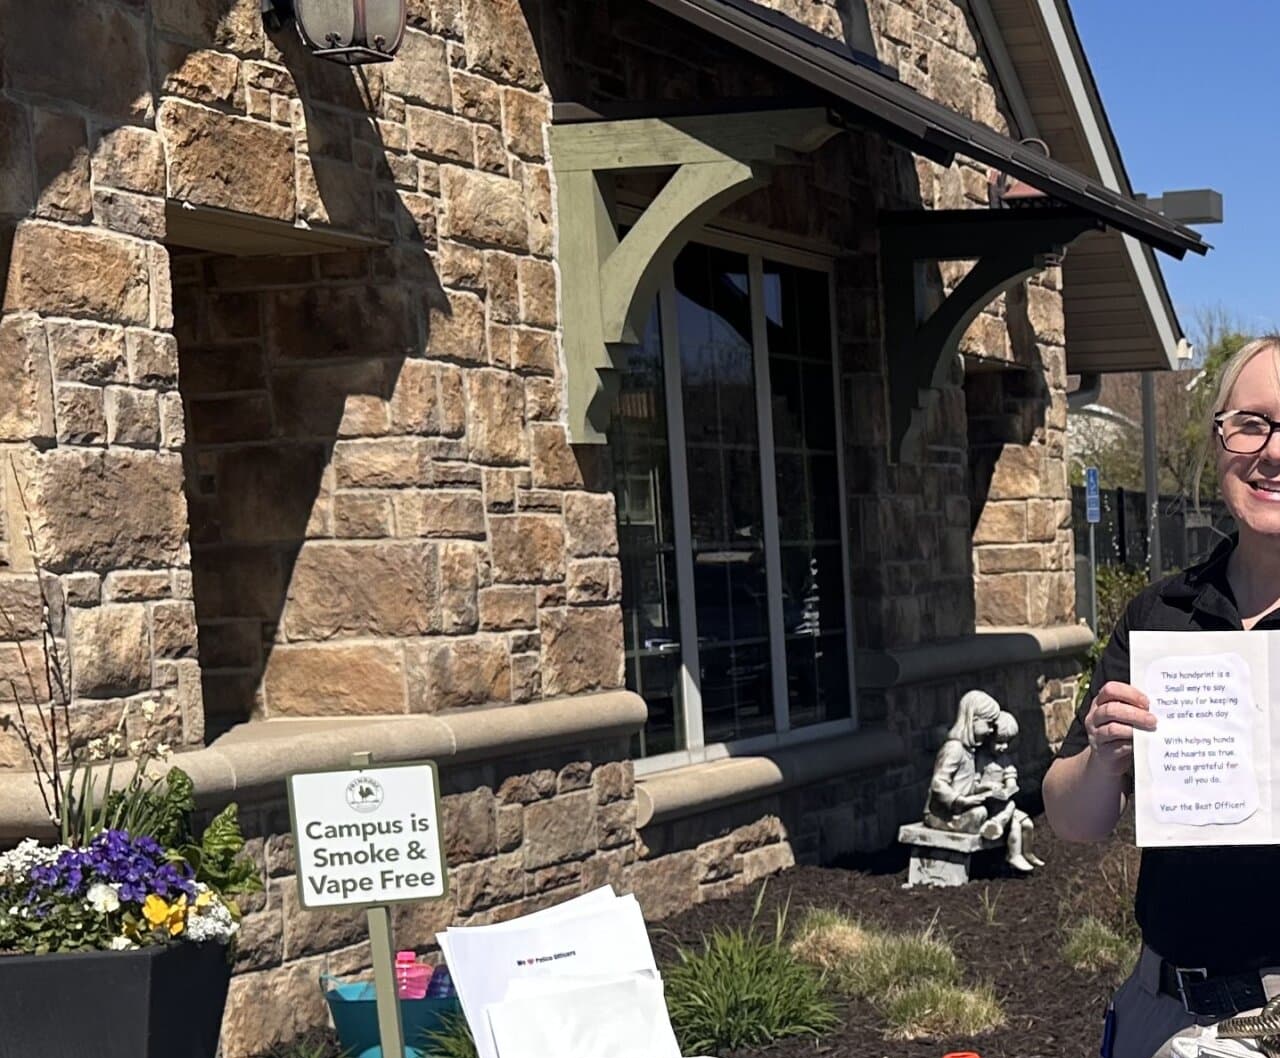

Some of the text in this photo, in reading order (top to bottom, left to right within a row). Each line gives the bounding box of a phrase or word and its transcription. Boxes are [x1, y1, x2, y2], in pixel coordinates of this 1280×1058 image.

[1160, 671, 1177, 679] This
[1179, 672, 1214, 680] handprint
[1163, 737, 1183, 745] With
[1184, 737, 1212, 746] helping
[1195, 778, 1208, 786] you
[1194, 802, 1212, 810] Best
[305, 813, 429, 841] Campus is
[313, 840, 427, 868] Smoke &
[308, 869, 435, 899] Vape Free
